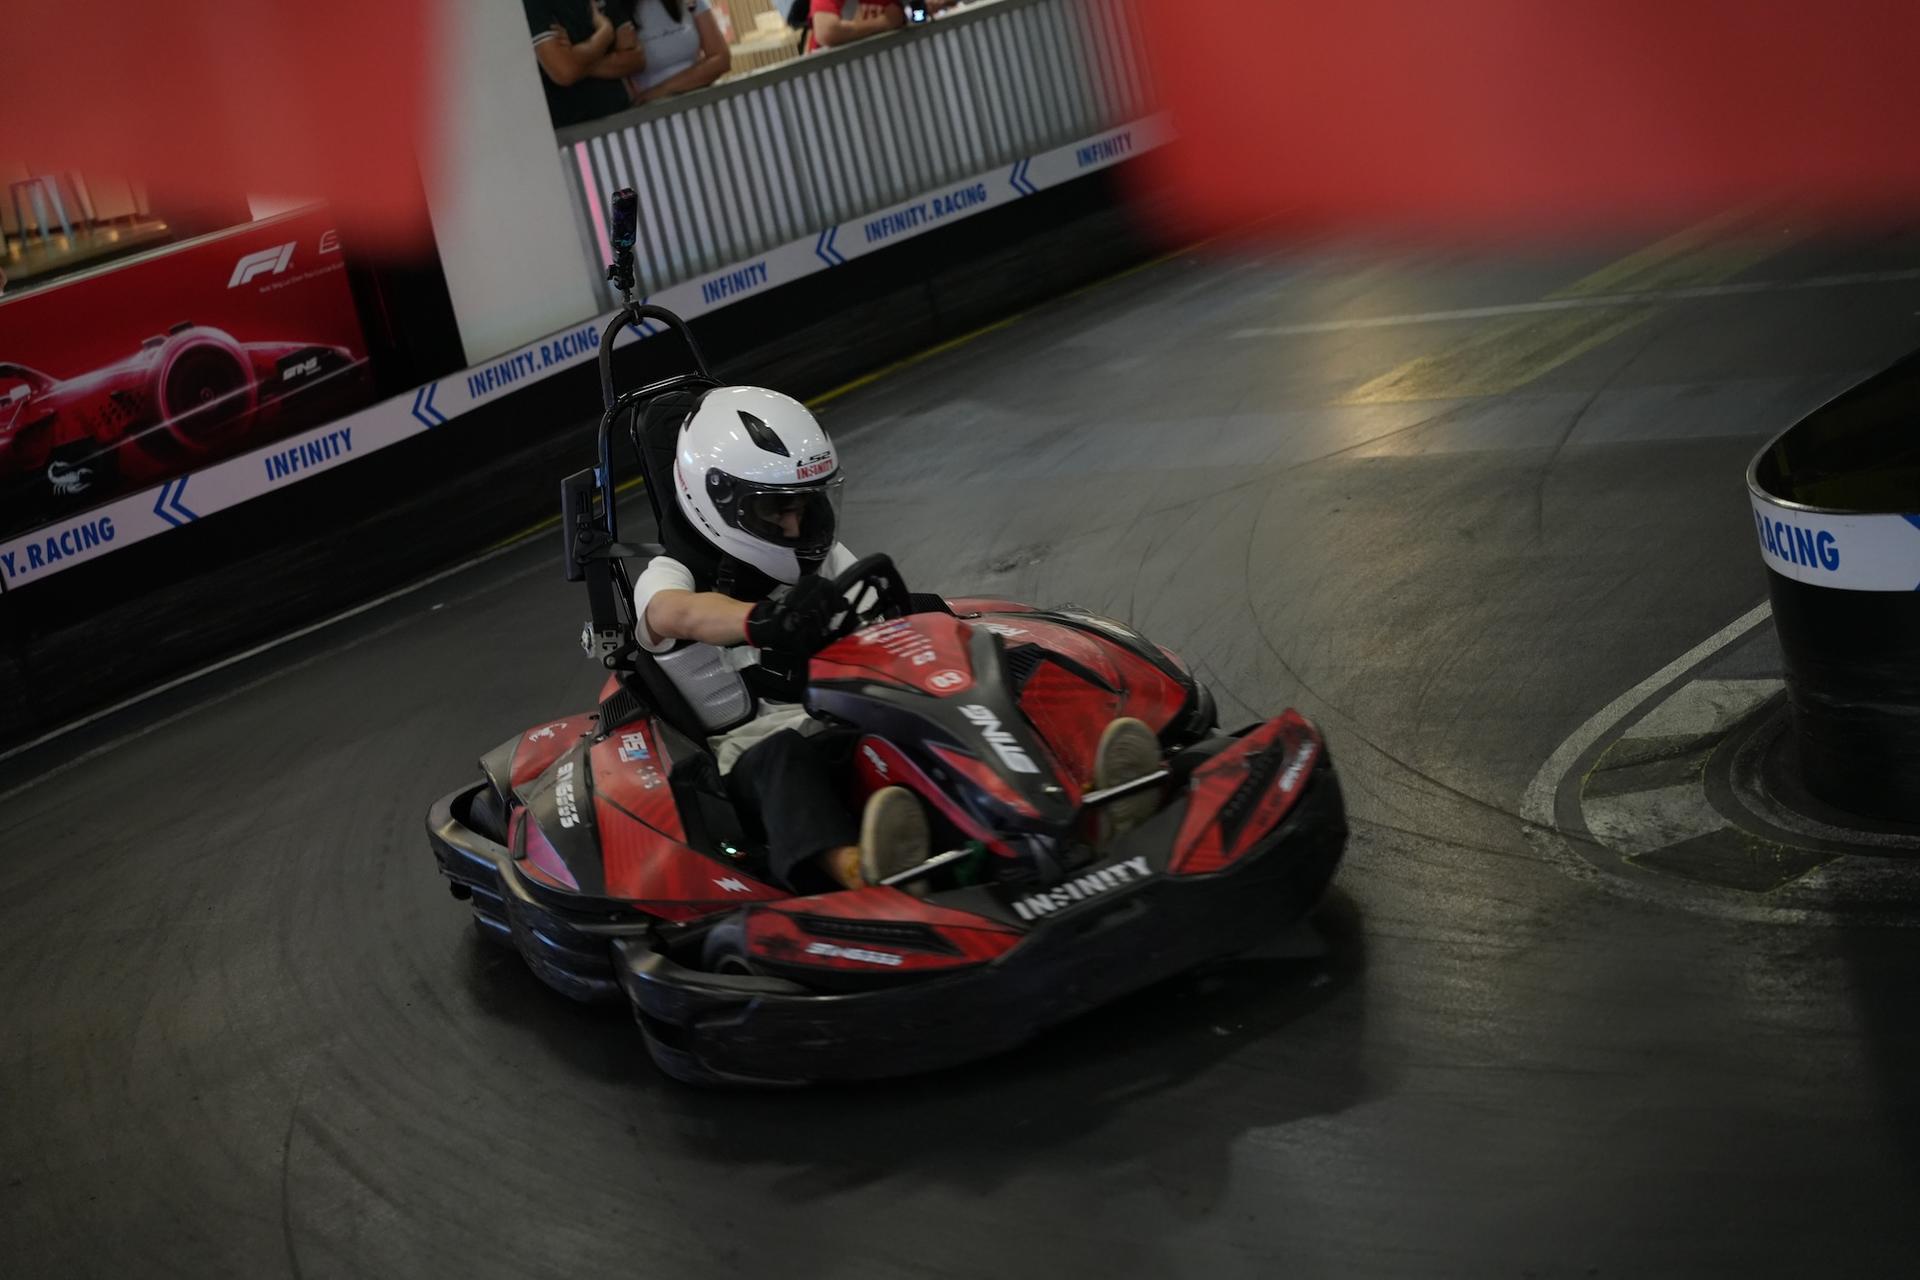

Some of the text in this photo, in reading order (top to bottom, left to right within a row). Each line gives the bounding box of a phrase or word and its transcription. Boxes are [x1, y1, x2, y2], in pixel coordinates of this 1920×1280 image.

[1076, 132, 1132, 168] INFINITY
[865, 184, 987, 243] INFINITY.RACING
[227, 241, 297, 289] F1
[702, 261, 768, 305] INFINITY
[468, 325, 600, 399] INFINITY.RACING
[265, 428, 353, 481] INFINITY
[1755, 509, 1840, 572] RACING
